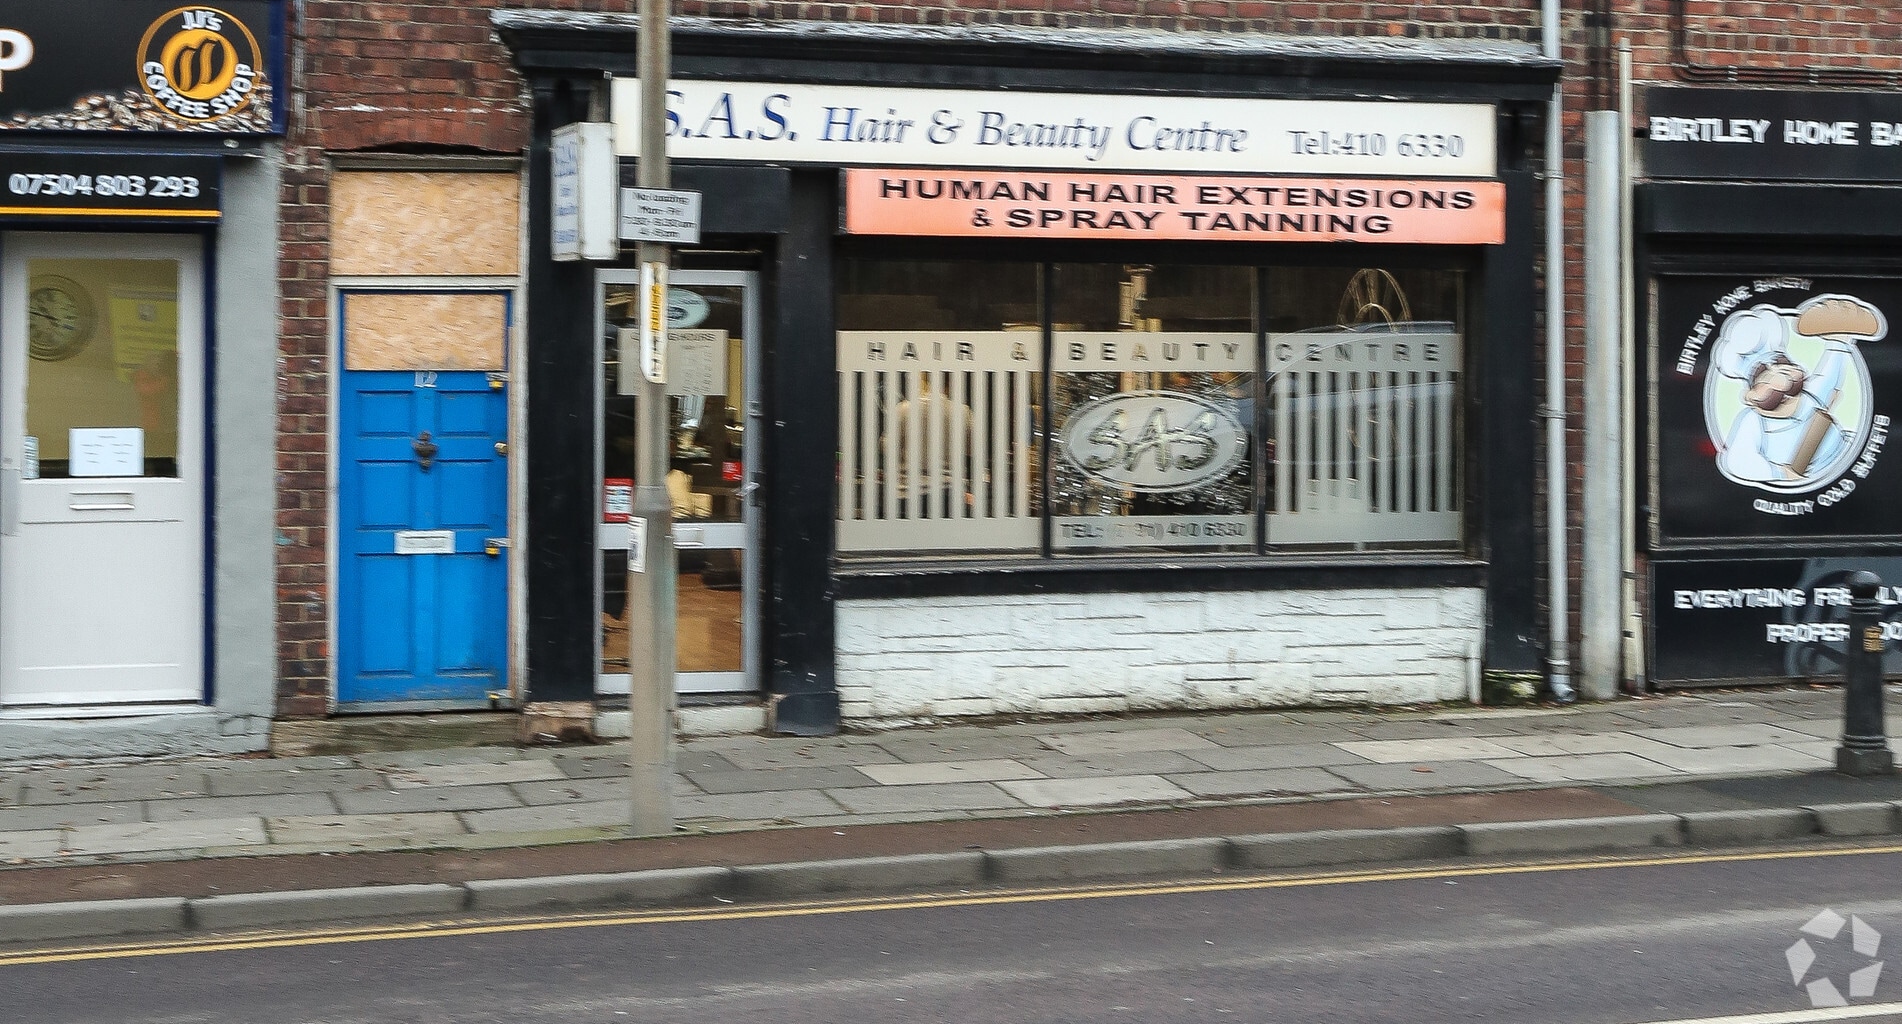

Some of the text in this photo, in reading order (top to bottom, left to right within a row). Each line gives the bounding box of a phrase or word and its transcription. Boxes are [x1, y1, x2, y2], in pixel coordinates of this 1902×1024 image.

[143, 61, 256, 118] COFFEE SHOP
[818, 106, 914, 143] Hair
[928, 109, 963, 144] &
[975, 111, 1111, 161] Beauty
[1128, 116, 1249, 152] Centre
[1397, 132, 1465, 158] 6330
[1650, 116, 1771, 144] BIRTLEY
[1784, 120, 1859, 145] HOME
[9, 174, 200, 197] 07504 803 293
[878, 179, 1477, 210] HUMAN HAIR EXTENSIONS
[971, 208, 1393, 234] & SPRAY TANNING
[866, 342, 1440, 363] HAIR & BEAUTY CENTRE
[1060, 523, 1104, 538] TEL:
[1674, 586, 1902, 609] EVERYTHING FRELY
[1766, 623, 1850, 643] PROPER
